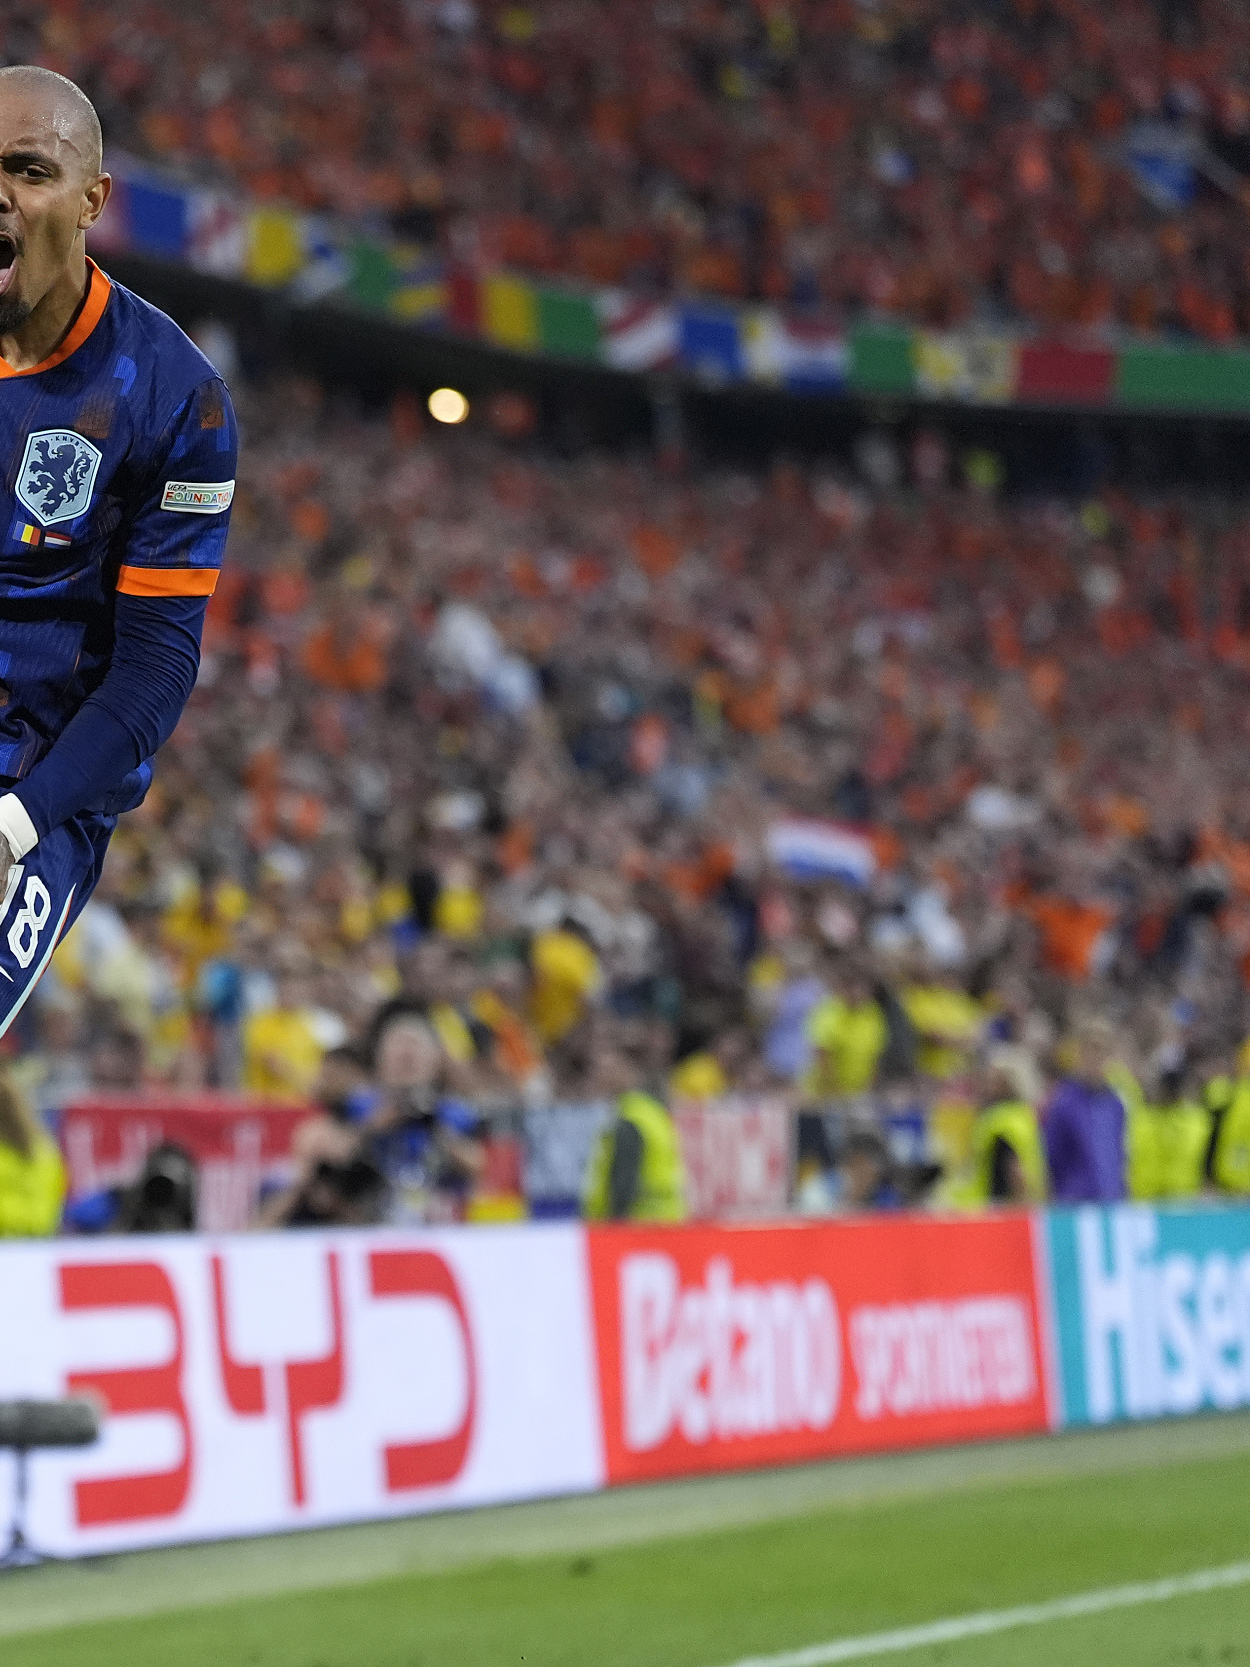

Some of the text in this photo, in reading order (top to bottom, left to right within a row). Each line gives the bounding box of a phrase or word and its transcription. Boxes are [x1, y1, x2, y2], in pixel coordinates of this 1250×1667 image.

[167, 483, 188, 492] UEFA
[58, 1247, 478, 1531] BYD
[618, 1252, 841, 1453] Betano
